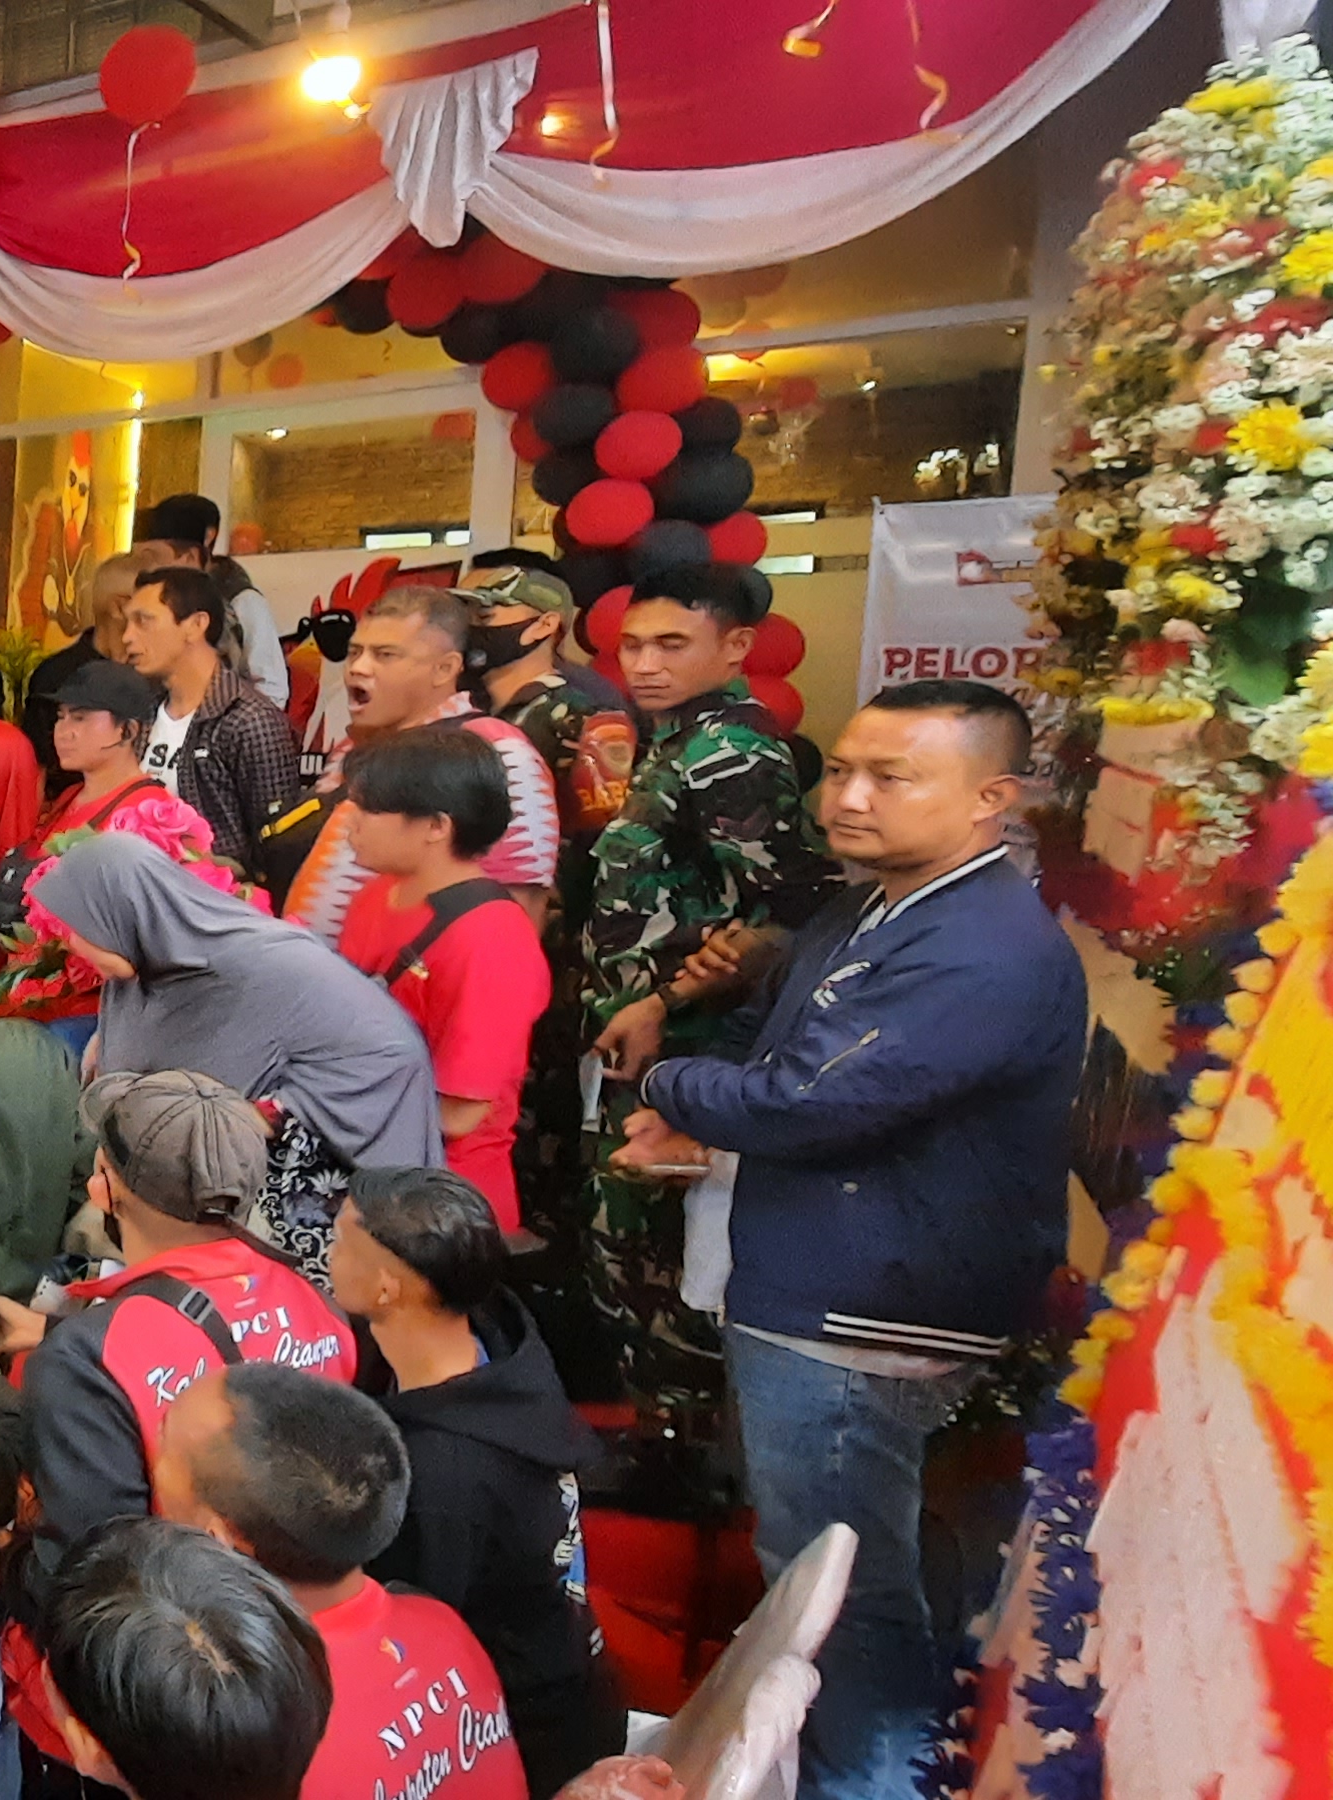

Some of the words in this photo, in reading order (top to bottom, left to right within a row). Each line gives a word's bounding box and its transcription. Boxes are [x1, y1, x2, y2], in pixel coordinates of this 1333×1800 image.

[149, 743, 182, 770] SA
[230, 1305, 291, 1343] PCI
[377, 1666, 469, 1761] NPCI
